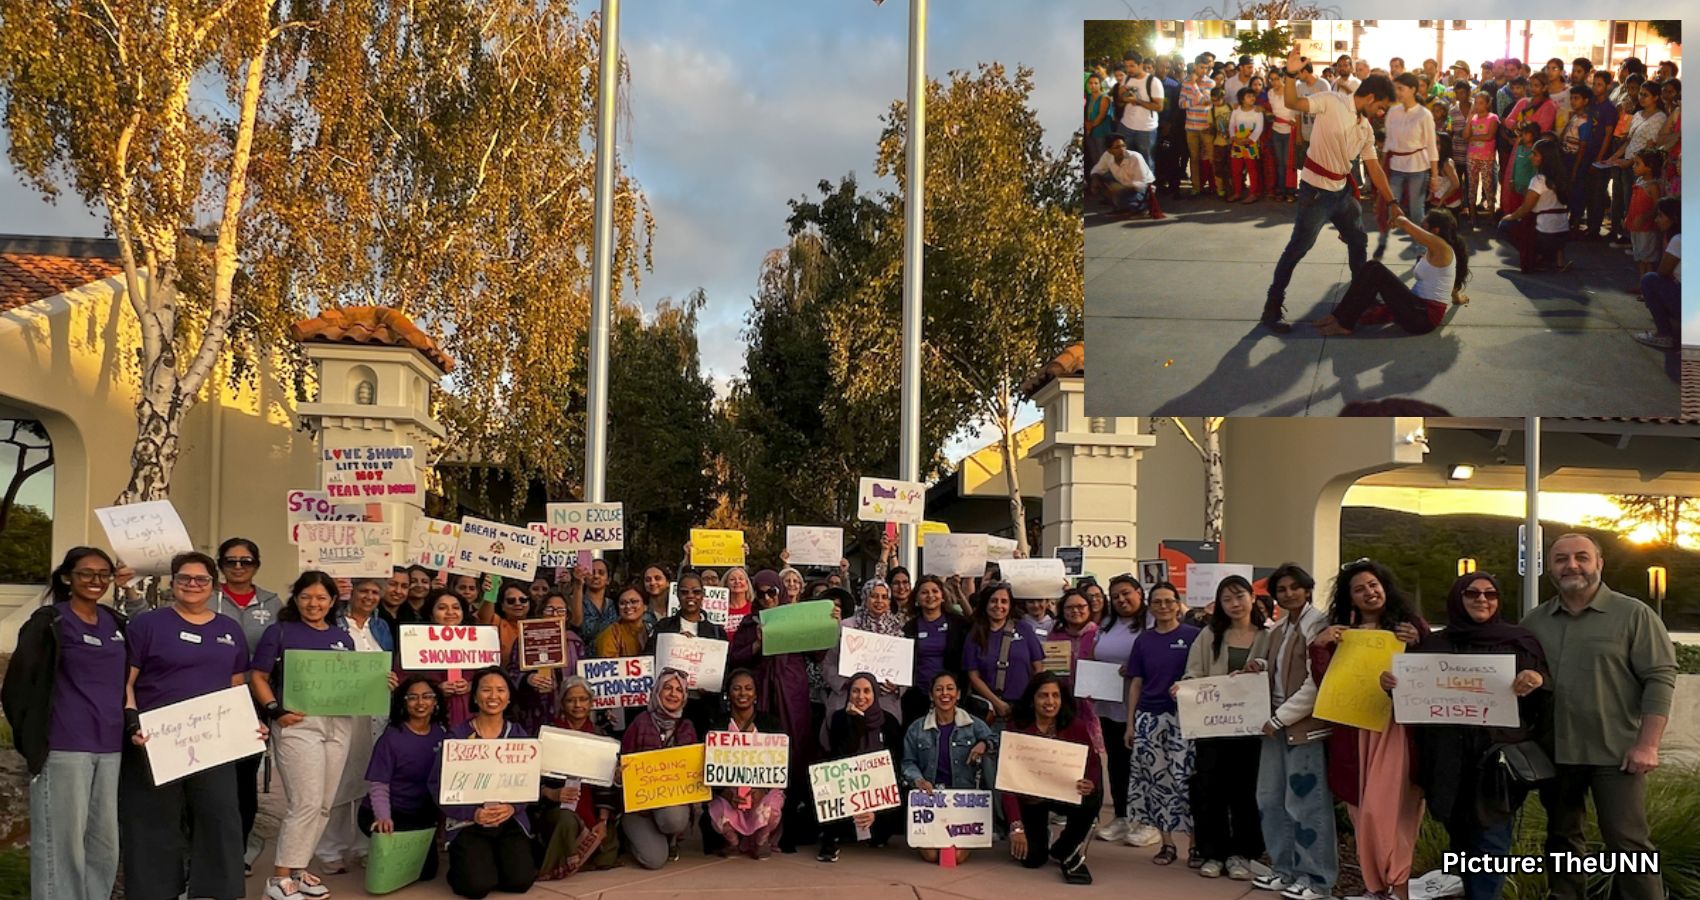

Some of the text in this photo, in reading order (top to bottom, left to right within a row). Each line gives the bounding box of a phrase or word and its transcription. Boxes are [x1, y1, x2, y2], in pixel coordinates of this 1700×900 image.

[366, 448, 413, 460] SHOULD
[336, 462, 359, 470] LIFT
[382, 461, 393, 470] UP
[355, 470, 384, 480] NOT
[327, 484, 360, 497] TEAR
[362, 484, 384, 496] YOU
[554, 508, 622, 524] NO EXCUSE
[303, 524, 357, 546] YOUR
[428, 521, 461, 538] LOV
[464, 522, 497, 538] BREAK
[510, 532, 536, 546] CYCLE
[550, 527, 580, 544] FOR
[583, 527, 622, 542] ABUSE
[1077, 534, 1127, 548] 3300-B
[320, 547, 365, 558] MATTERS
[460, 550, 472, 562] BE
[492, 556, 528, 572] CHANGE
[428, 626, 477, 641] LOVE
[584, 660, 642, 679] HOPE IS
[591, 676, 654, 696] TRONGER
[1436, 676, 1486, 688] LIGHT
[620, 693, 648, 706] FEAR
[1430, 704, 1489, 724] RISE!
[708, 732, 788, 746] REAL LOVE
[447, 742, 490, 762] BREAK
[714, 749, 787, 765] RESPECTS
[635, 760, 687, 776] HOLDING
[706, 764, 787, 784] BOUNDARIES
[812, 763, 850, 785] STOP
[856, 756, 892, 772] VIOLENCE
[838, 774, 871, 794] END
[818, 784, 900, 819] THE SILENCE
[913, 809, 934, 824] END
